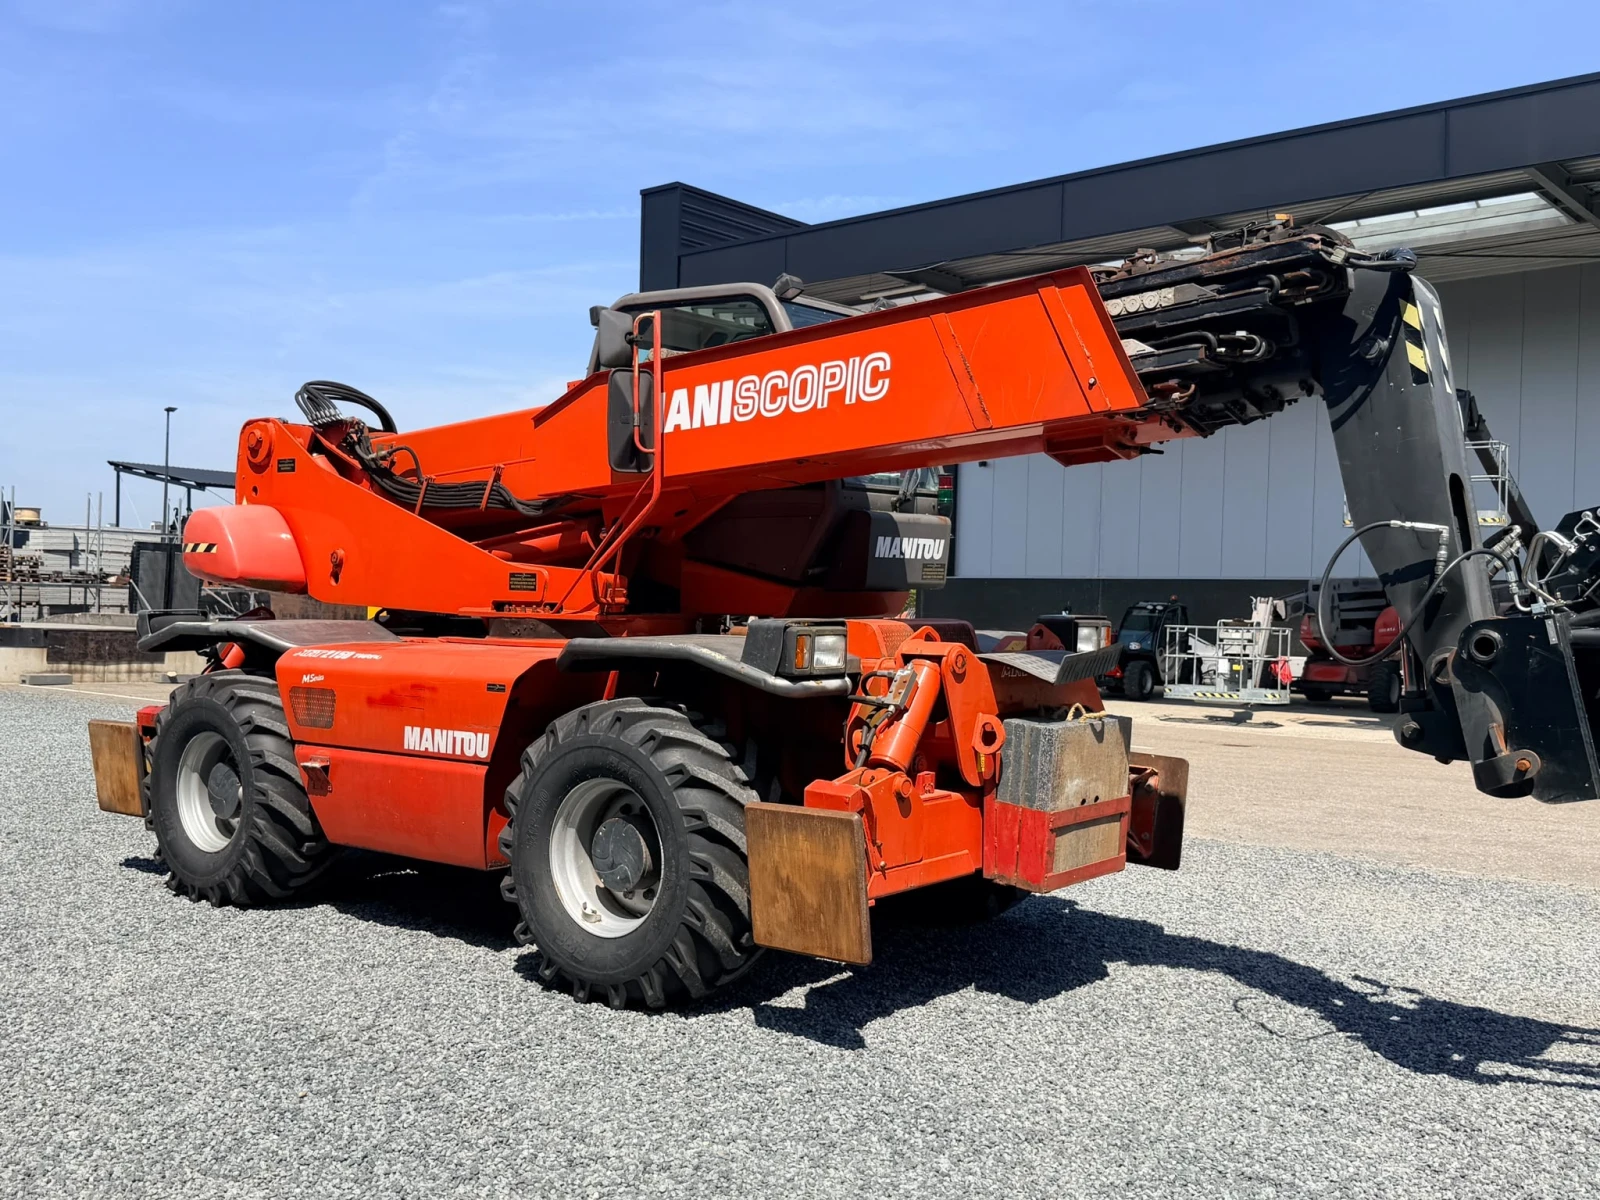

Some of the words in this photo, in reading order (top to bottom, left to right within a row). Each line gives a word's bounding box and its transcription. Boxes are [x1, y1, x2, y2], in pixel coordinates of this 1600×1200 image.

[662, 351, 892, 433] ANISCOPIC
[875, 536, 945, 560] MANITOU
[403, 725, 490, 759] MANITOU
